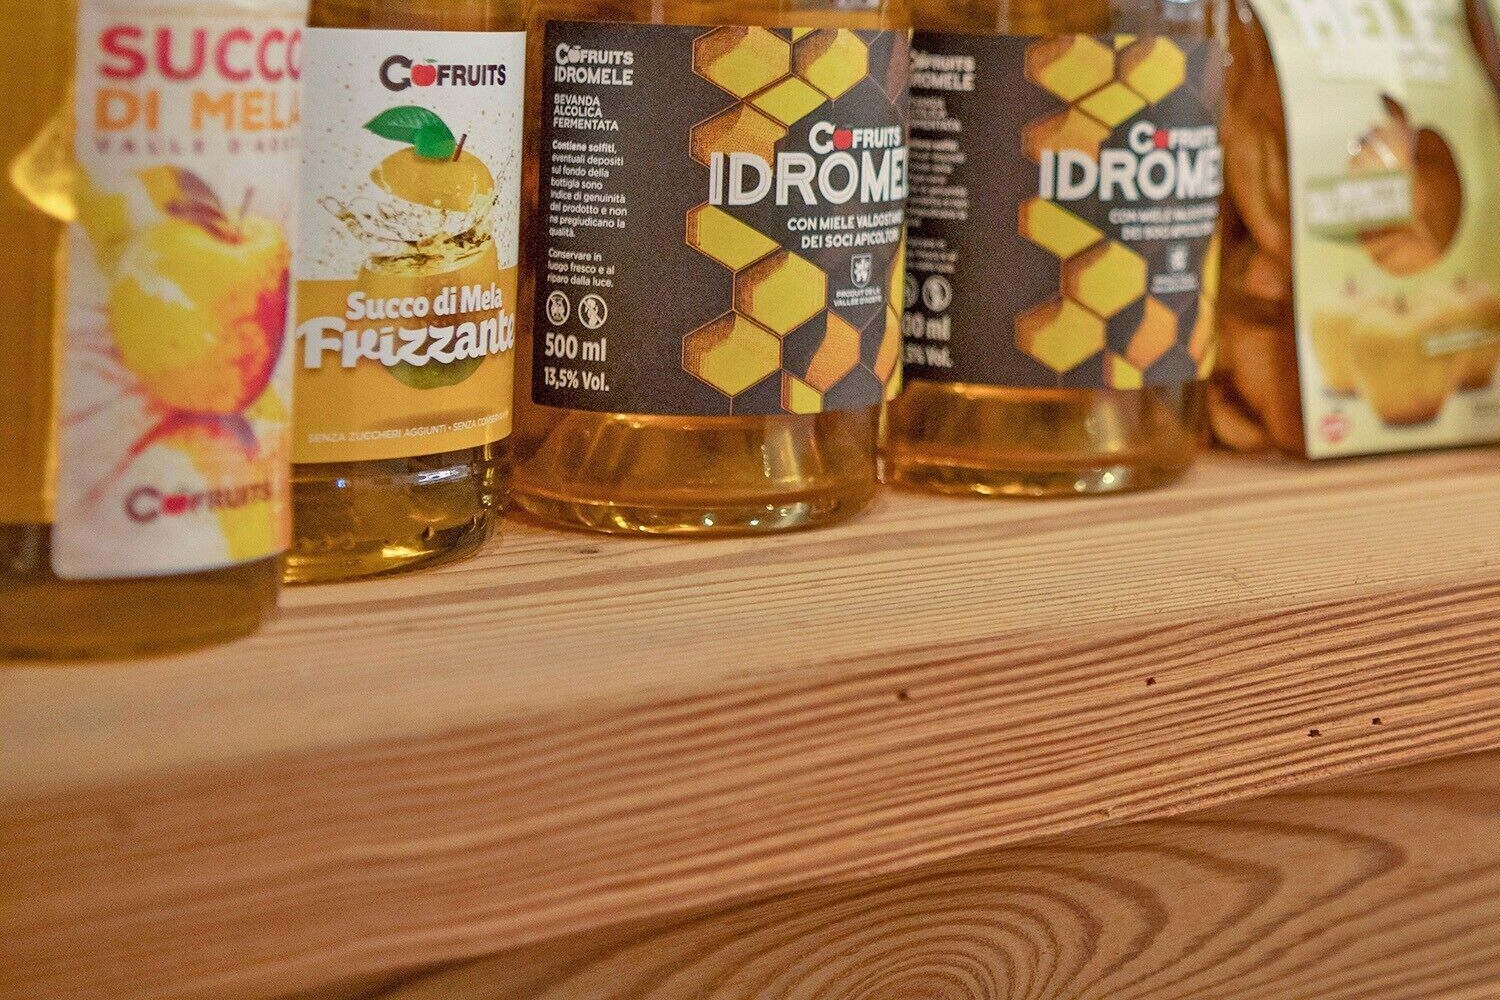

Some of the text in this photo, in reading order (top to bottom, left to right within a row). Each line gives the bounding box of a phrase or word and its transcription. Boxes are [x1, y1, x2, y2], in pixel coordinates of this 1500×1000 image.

[555, 43, 634, 65] COFRUITS
[379, 55, 506, 92] COFRUITS
[554, 65, 633, 86] IDROMELE
[554, 93, 600, 106] BEVANDA
[95, 89, 160, 131] DI
[553, 105, 602, 118] ALCOLICA
[553, 116, 619, 131] FERMENTATA
[809, 121, 901, 154] COFRUITS
[552, 140, 587, 152] Contiene
[587, 155, 624, 167] depositi
[562, 165, 586, 176] fondo
[587, 168, 610, 178] della
[709, 146, 908, 206] IDROME
[581, 181, 603, 190] sono
[573, 191, 582, 200] di
[583, 194, 626, 203] genuinità
[549, 201, 561, 211] del
[562, 203, 599, 214] prodotto
[609, 207, 628, 216] non
[560, 216, 615, 228] pregiudicano
[616, 218, 626, 229] la
[787, 217, 817, 231] CON
[819, 214, 854, 230] MIELE
[801, 235, 823, 249] DEI
[825, 232, 853, 248] SOCI
[548, 248, 602, 261] Conservare in
[547, 261, 569, 272] luogo
[570, 262, 596, 274] fresco
[606, 265, 615, 275] al
[547, 274, 614, 287] riparo dalla luce.
[347, 282, 503, 320] Succo di Mela
[296, 310, 515, 369] Frizzante
[545, 332, 607, 361] 500 ml
[544, 366, 610, 391] 13,5% Vol.
[308, 432, 346, 443] SENZA
[350, 429, 402, 442] ZUCCHERI
[403, 425, 447, 438] AGGIUNTI
[452, 419, 477, 432] SENZA
